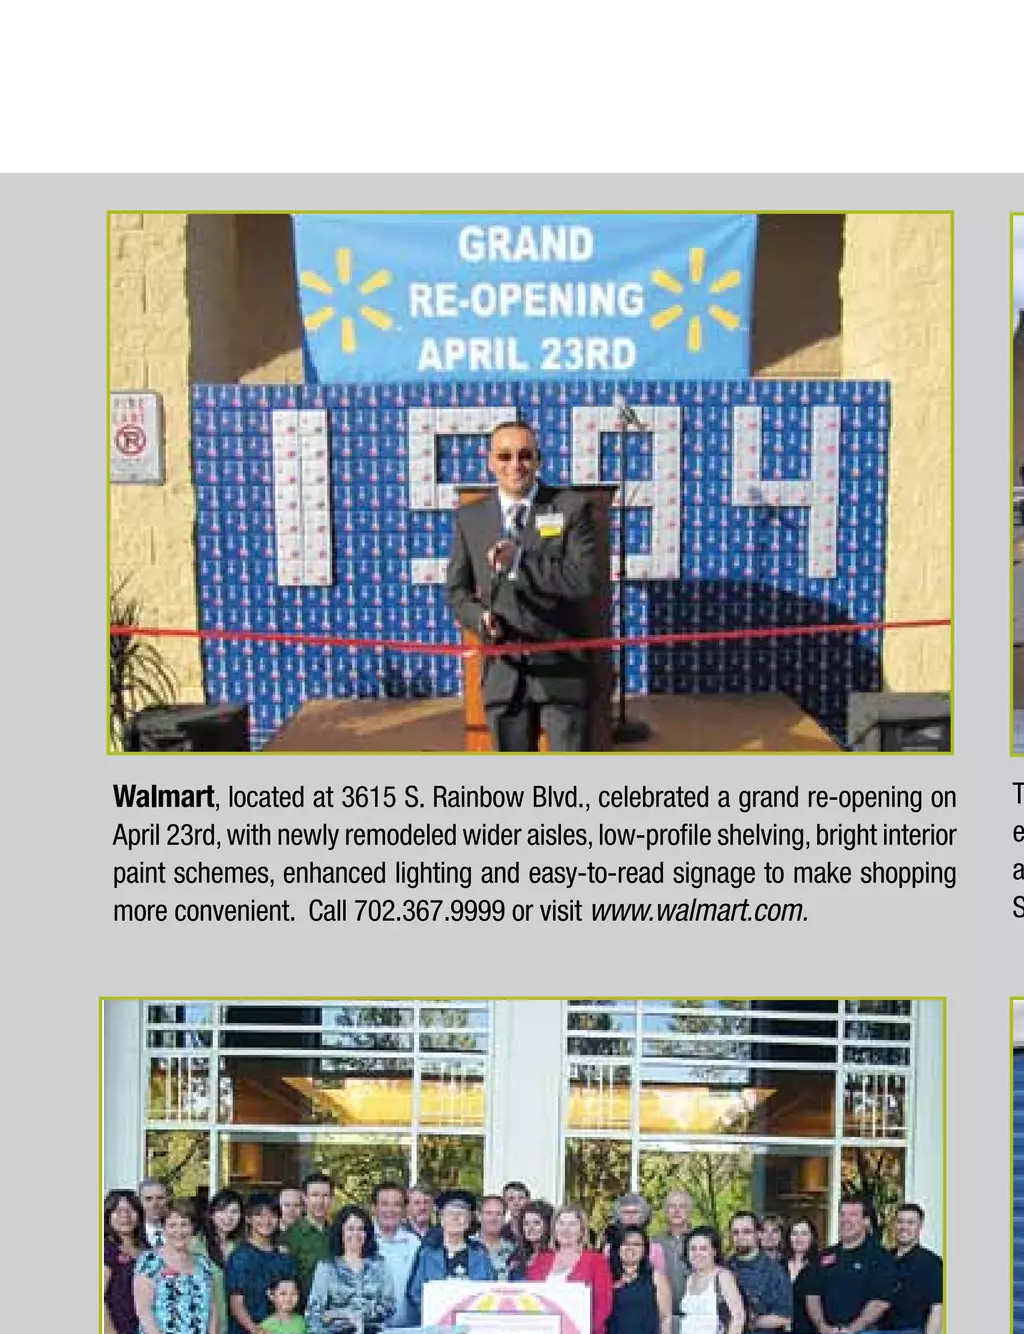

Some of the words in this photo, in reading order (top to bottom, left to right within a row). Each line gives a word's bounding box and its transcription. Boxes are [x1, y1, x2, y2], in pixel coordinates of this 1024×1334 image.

[458, 225, 594, 262] GRAND
[409, 282, 645, 319] RE-OPENING
[418, 338, 529, 372] APRIL
[540, 338, 637, 371] 23RD
[112, 783, 220, 812] Walmart,
[228, 784, 305, 809] located
[312, 785, 335, 809] at
[341, 785, 397, 809] 3615
[404, 784, 425, 809] S.
[433, 785, 525, 809] Rainbow
[533, 784, 591, 812] Blvd.,
[598, 784, 709, 809] celebrated
[717, 789, 731, 809] a
[738, 785, 799, 814] grand
[808, 785, 923, 814] re-opening
[930, 789, 957, 809] on
[113, 861, 167, 889] paint
[173, 860, 275, 888] schemes,
[283, 860, 386, 884] enhanced
[395, 860, 472, 889] lighting
[480, 860, 520, 884] and
[528, 860, 664, 889] easy-to-read
[672, 860, 756, 889] signage
[763, 861, 785, 884] to
[793, 860, 852, 884] make
[860, 860, 957, 889] shopping
[113, 903, 168, 922] more
[174, 898, 296, 922] convenient.
[308, 898, 347, 922] Call
[354, 899, 506, 922] 702.367.9999
[511, 903, 535, 922] or
[539, 898, 583, 922] visit
[591, 897, 808, 922] www.walmart.com.
